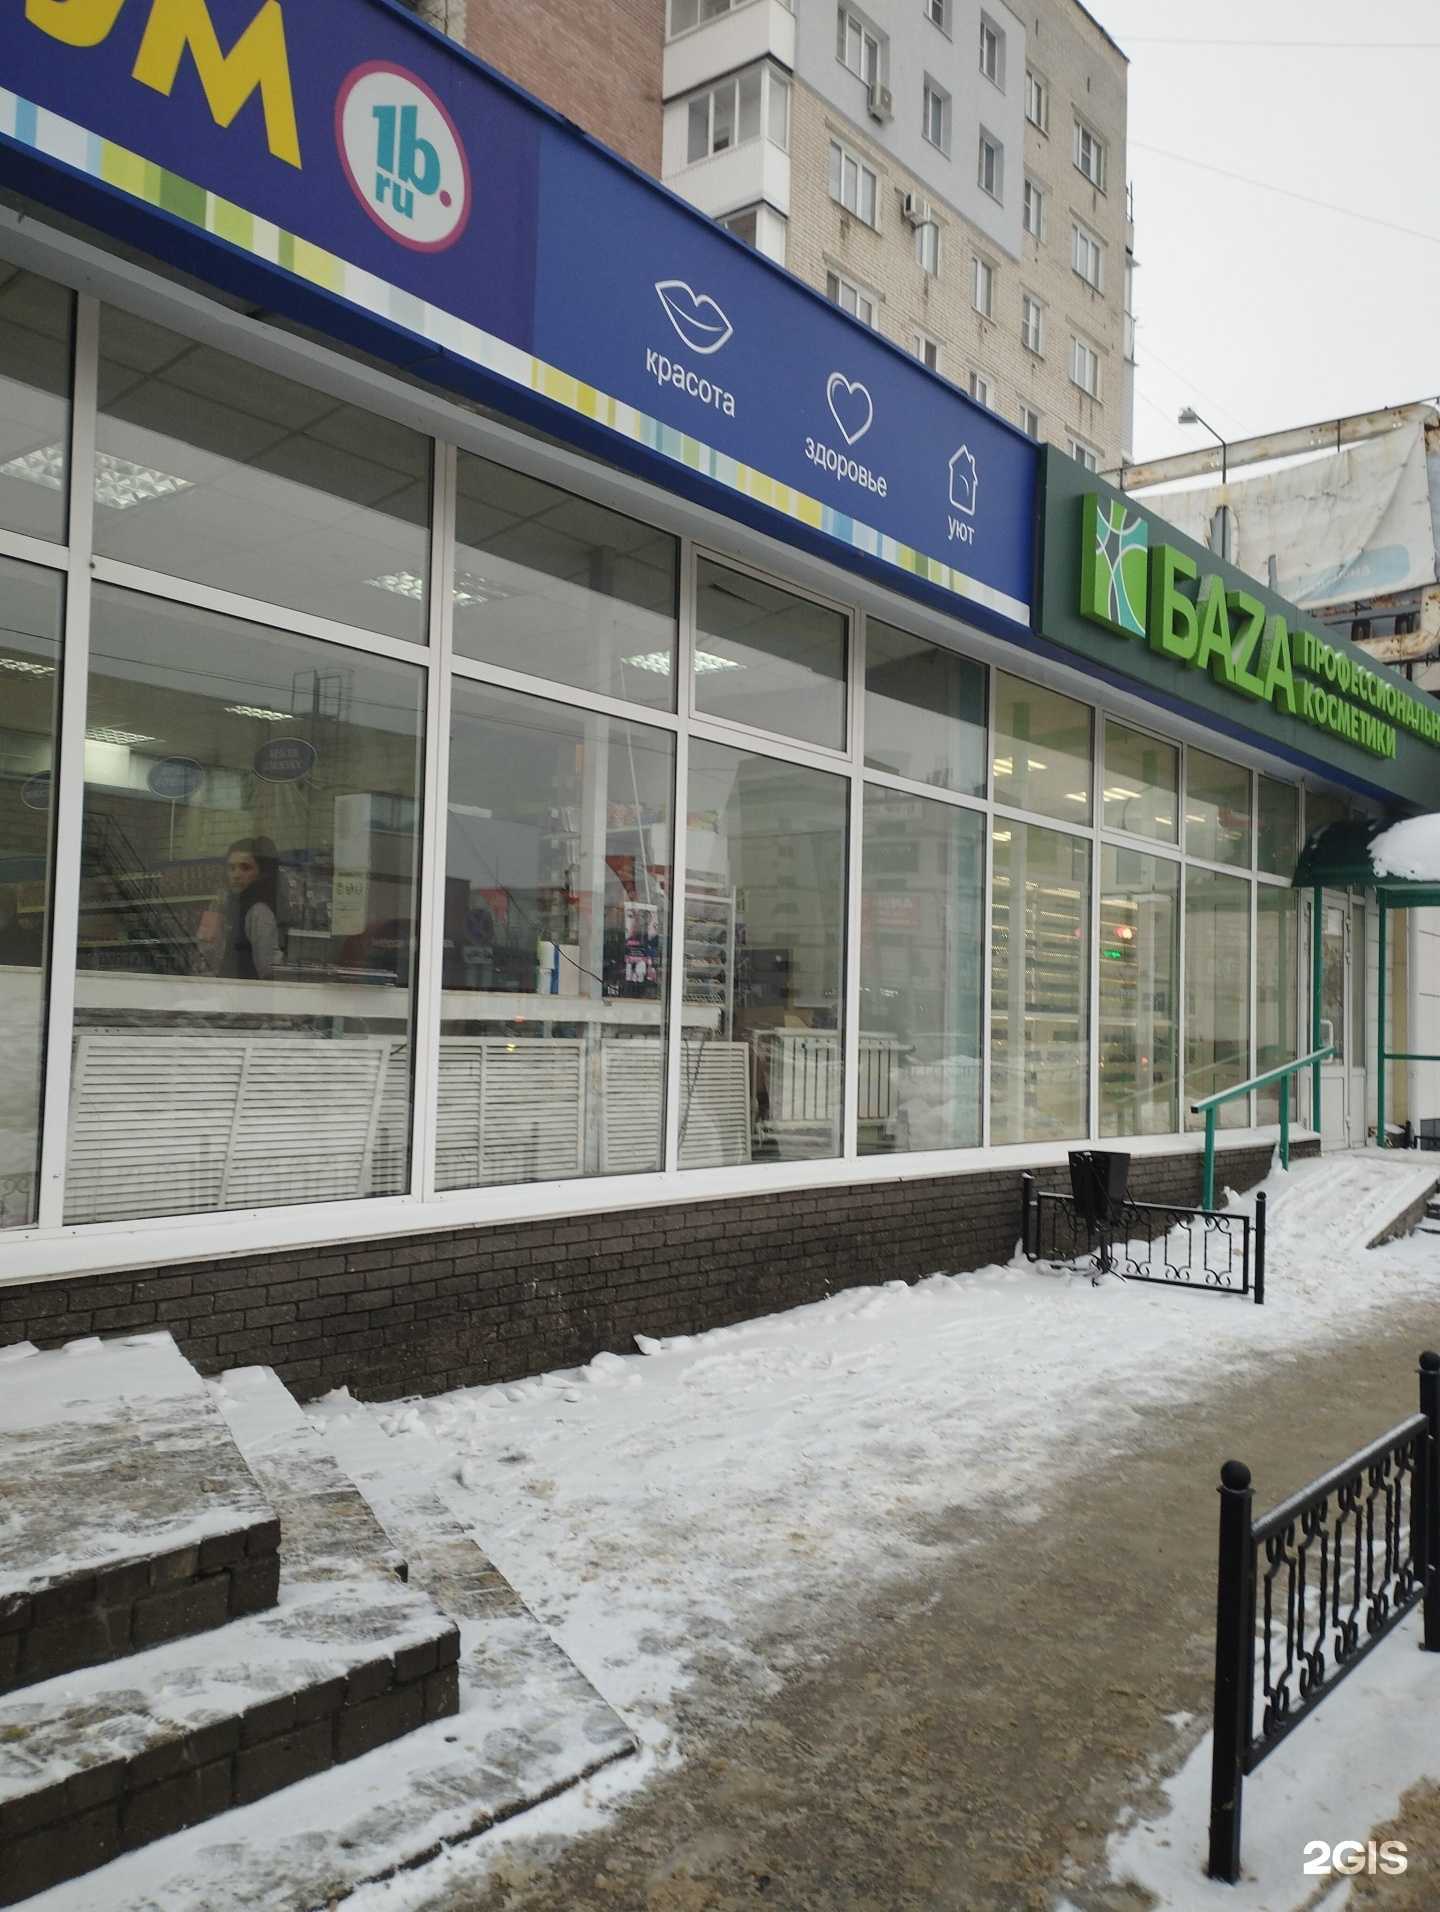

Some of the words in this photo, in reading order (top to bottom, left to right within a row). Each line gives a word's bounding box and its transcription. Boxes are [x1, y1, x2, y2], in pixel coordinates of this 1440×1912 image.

[374, 172, 414, 219] ru
[646, 347, 736, 418] красота
[804, 436, 888, 498] здоровье
[947, 514, 975, 545] уют
[1302, 678, 1397, 760] КОСМЕТИКИ
